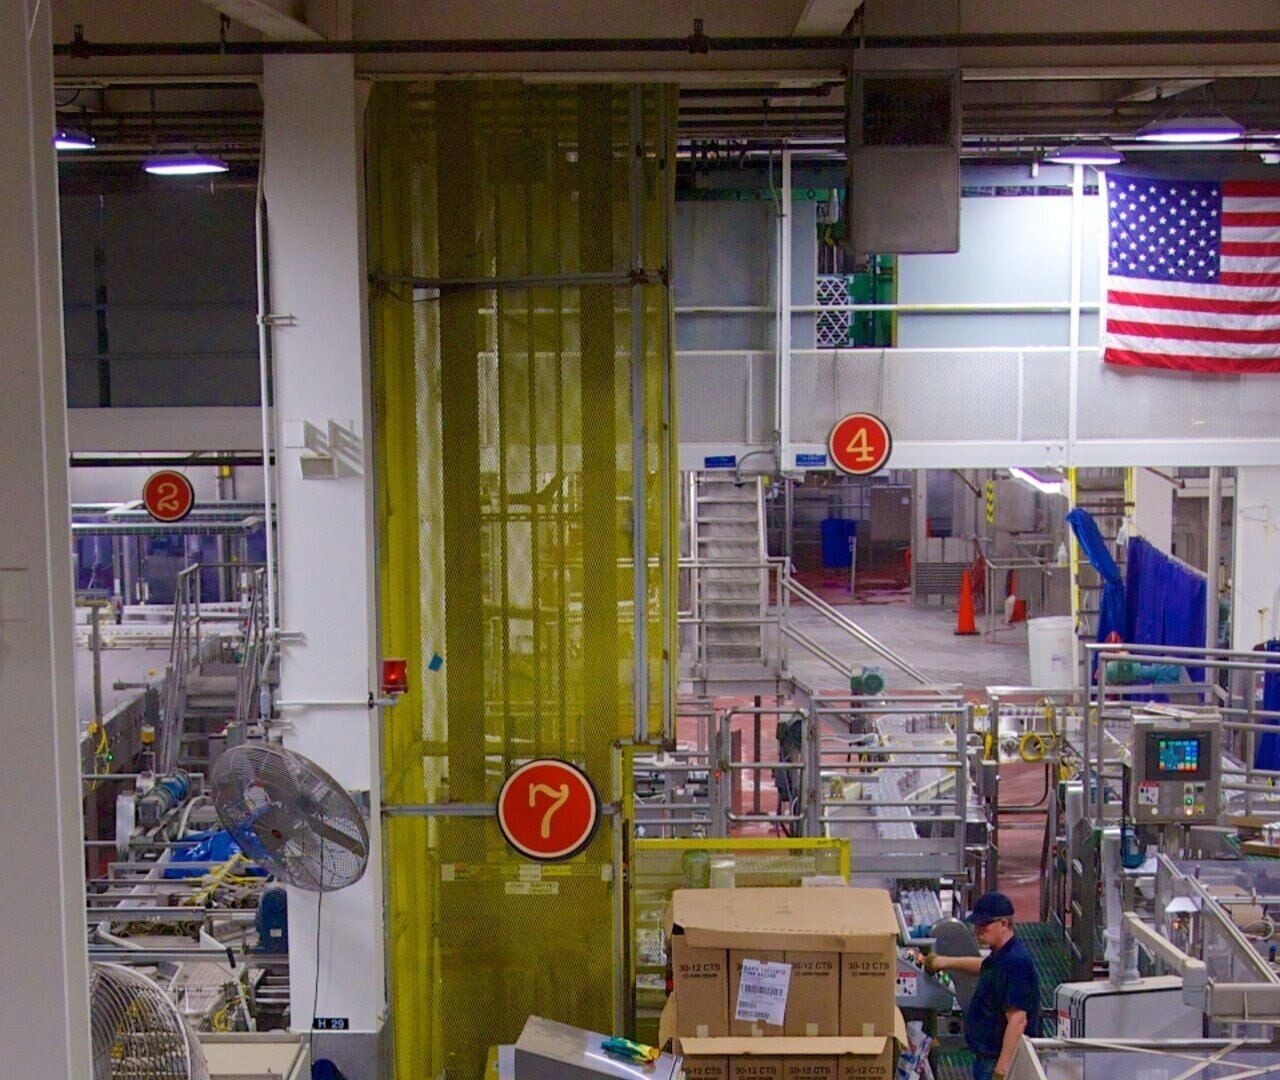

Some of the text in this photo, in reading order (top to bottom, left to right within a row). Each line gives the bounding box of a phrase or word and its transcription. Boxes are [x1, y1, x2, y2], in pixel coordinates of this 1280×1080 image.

[846, 428, 875, 461] 4
[157, 482, 179, 511] 2
[529, 783, 570, 838] 7
[679, 963, 721, 972] 30-12 CTS
[815, 962, 833, 970] CTS
[848, 962, 890, 970] 30-12 CTS
[318, 1018, 345, 1029] H 29
[704, 1067, 722, 1075] CTS
[735, 1067, 777, 1075] 30-12 CTS
[789, 1067, 831, 1075] 30-12 CTS
[845, 1067, 887, 1075] 30-12 CTS
